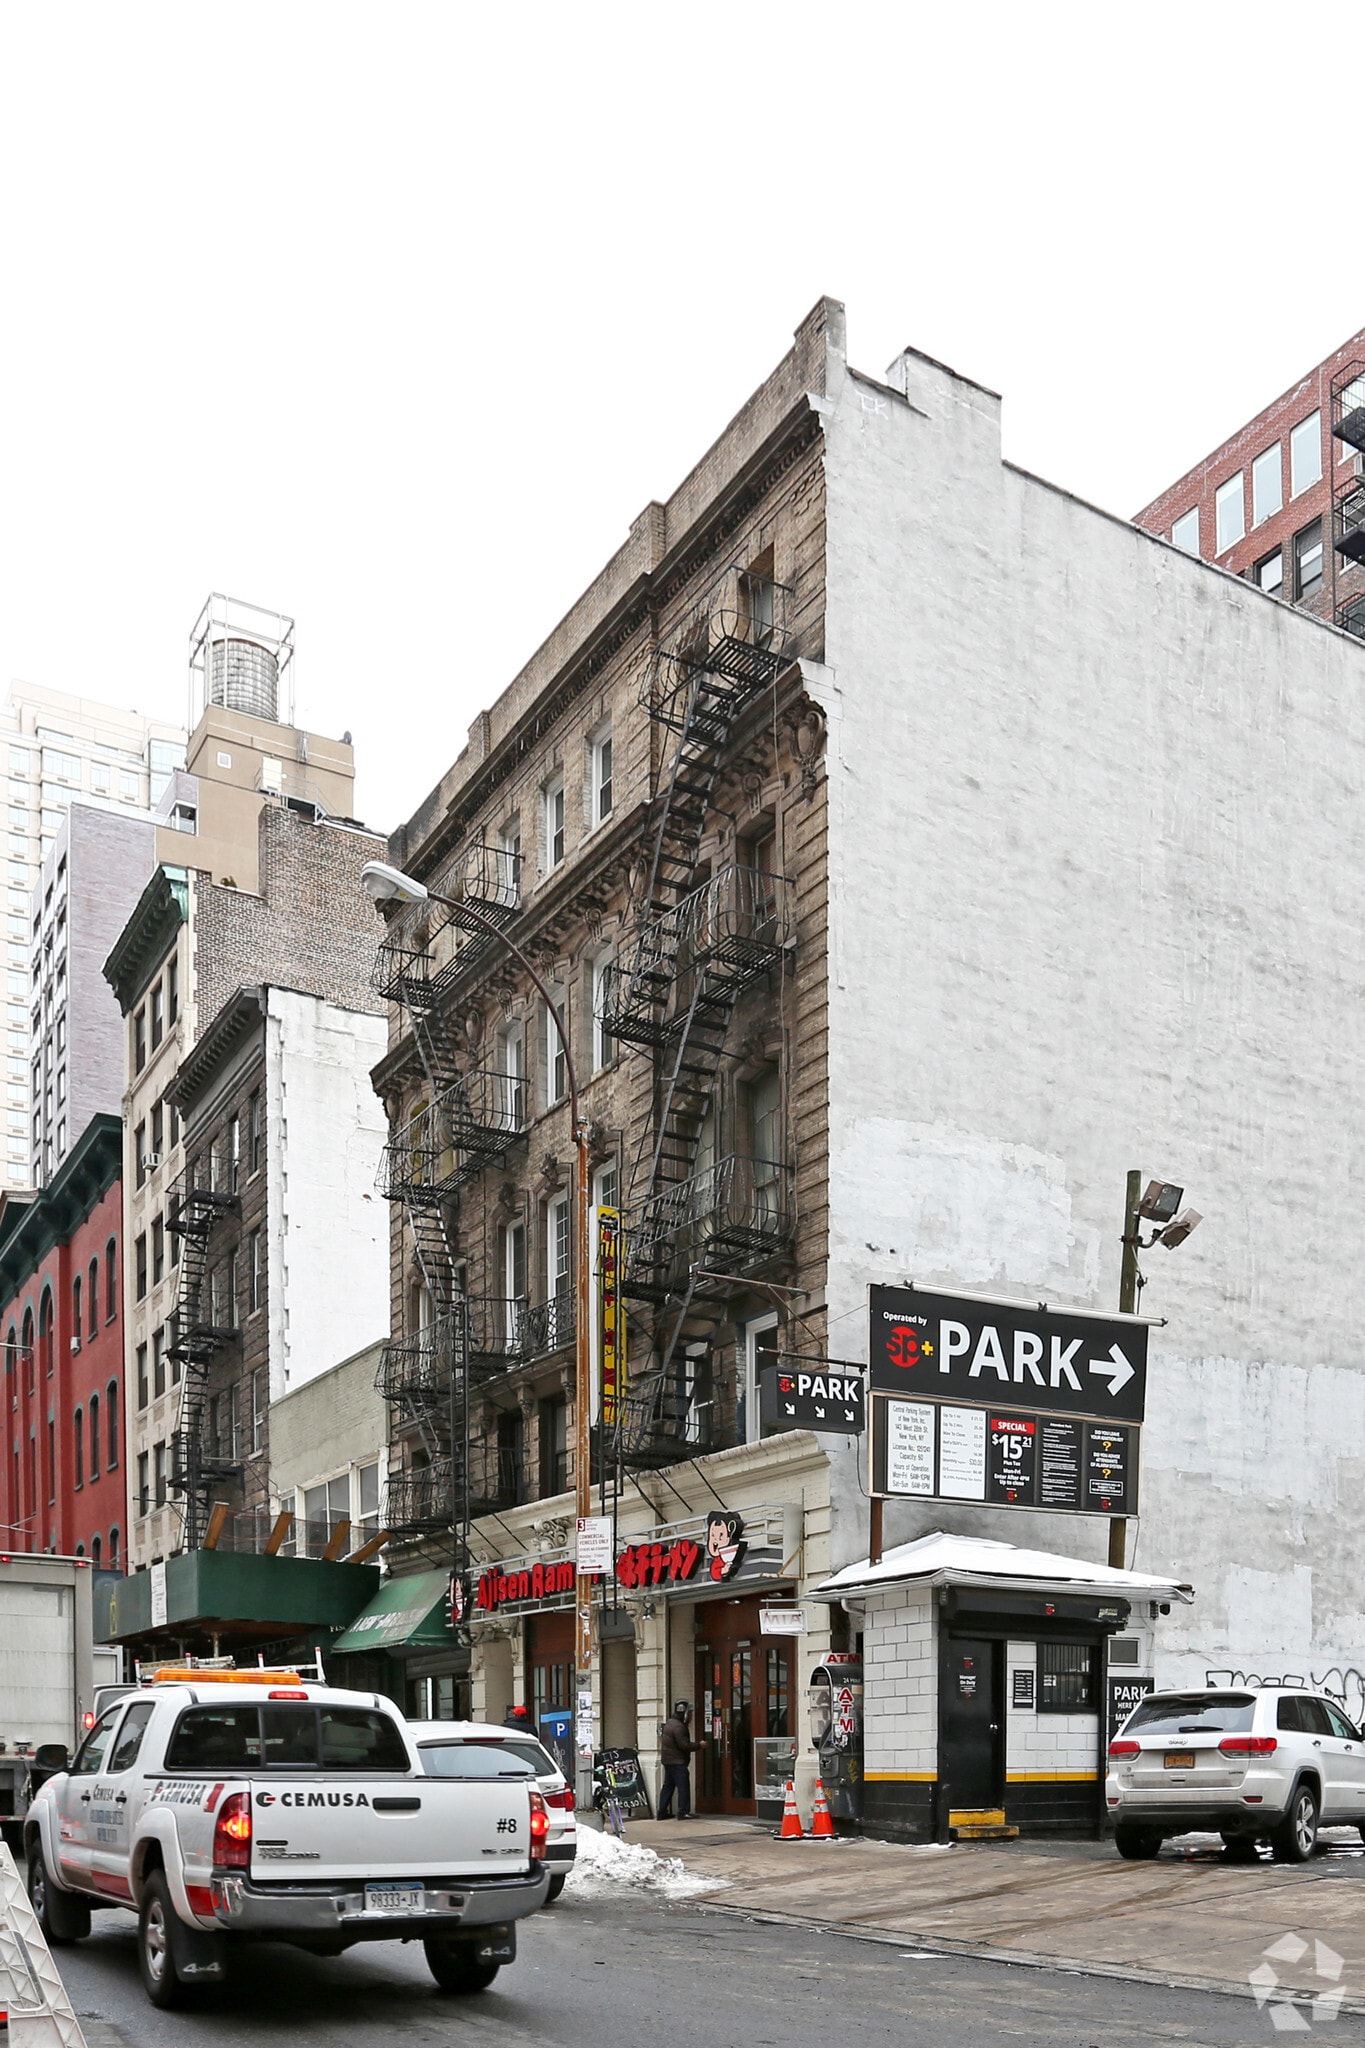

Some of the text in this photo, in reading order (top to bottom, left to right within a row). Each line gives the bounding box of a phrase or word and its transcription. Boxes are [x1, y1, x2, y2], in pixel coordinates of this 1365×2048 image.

[883, 1311, 928, 1327] Operated by
[938, 1319, 1084, 1392] PARK
[797, 1374, 860, 1402] PARK
[905, 1406, 917, 1416] Parking
[919, 1407, 931, 1416] System
[997, 1421, 1027, 1432] SPECIAL
[899, 1432, 907, 1440] New
[991, 1433, 1023, 1460] $15
[1102, 1441, 1112, 1452] ?
[1102, 1468, 1112, 1479] ?
[578, 1520, 585, 1531] 3
[477, 1561, 599, 1612] Ajisen Ram
[827, 1654, 861, 1664] ATM
[1114, 1686, 1149, 1700] PARK
[839, 1688, 854, 1734] ATM
[1117, 1702, 1133, 1710] HERE
[556, 1722, 566, 1737] P
[162, 1781, 207, 1806] CEMUSA
[281, 1792, 370, 1807] CEMUSA
[496, 1818, 517, 1834] #8
[258, 1852, 320, 1860] TACOMA
